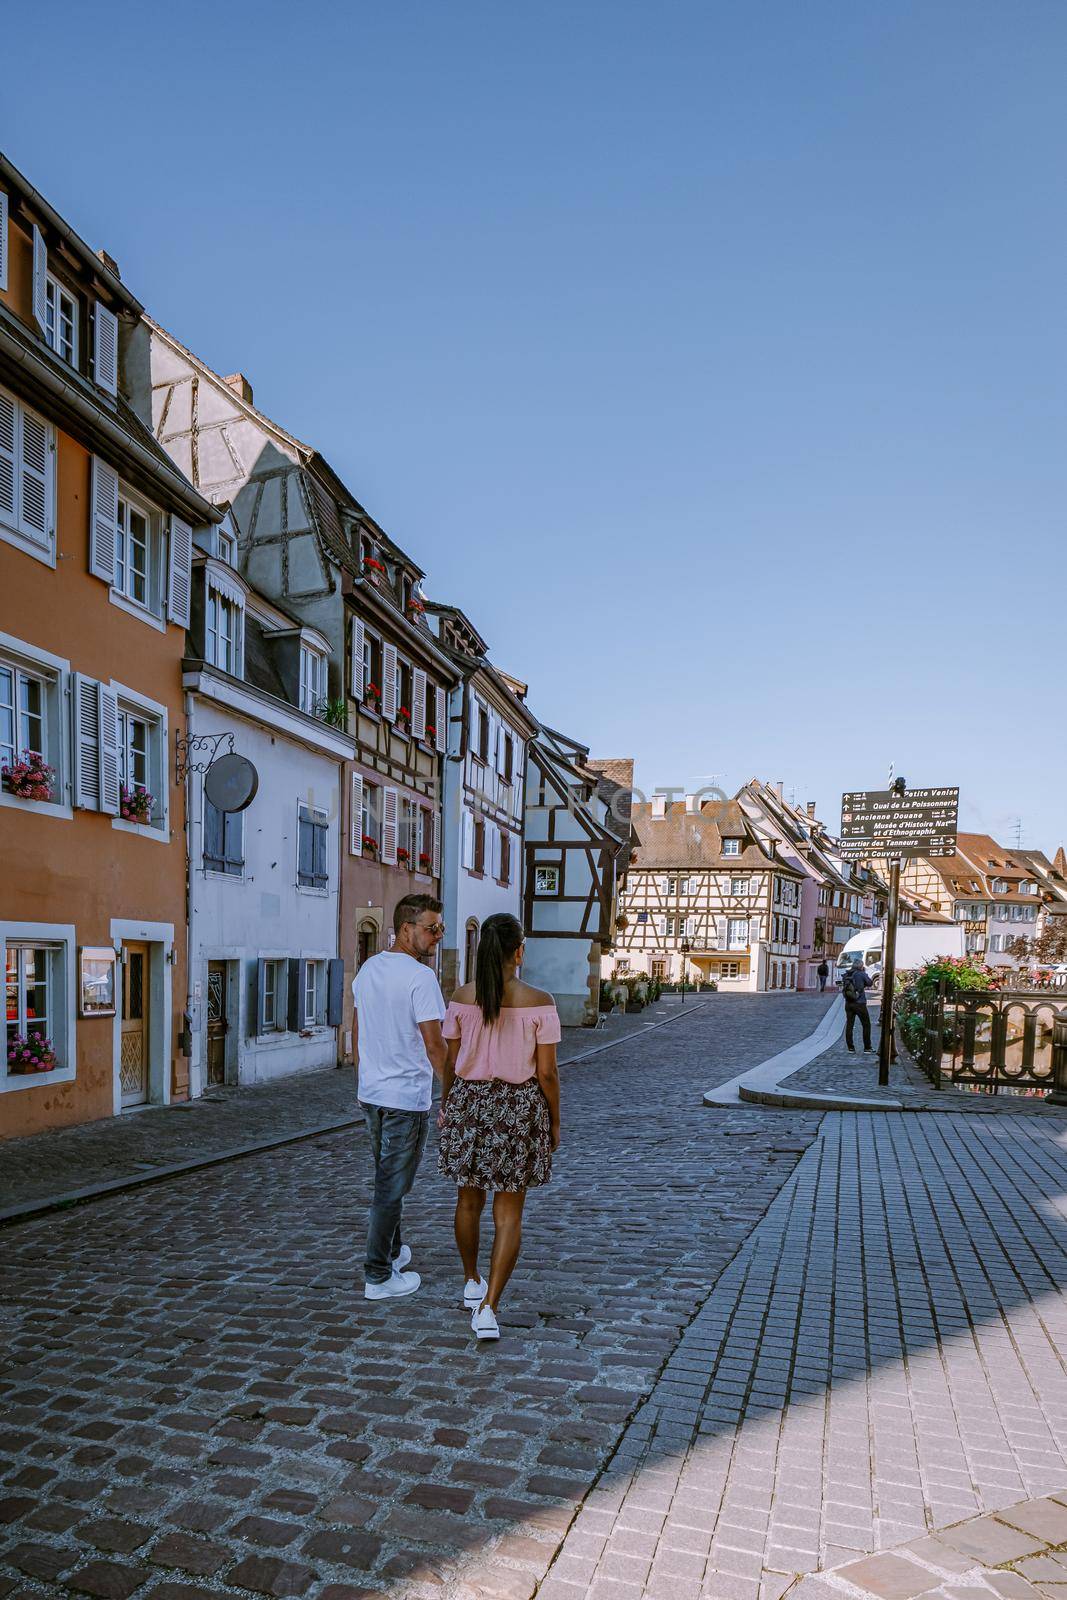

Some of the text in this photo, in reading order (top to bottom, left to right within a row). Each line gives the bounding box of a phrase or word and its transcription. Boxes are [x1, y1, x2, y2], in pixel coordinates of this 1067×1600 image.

[931, 789, 958, 797] Venise
[912, 800, 958, 808] Poissonnerie
[883, 828, 936, 837] d'Ethnographie
[871, 839, 884, 847] des
